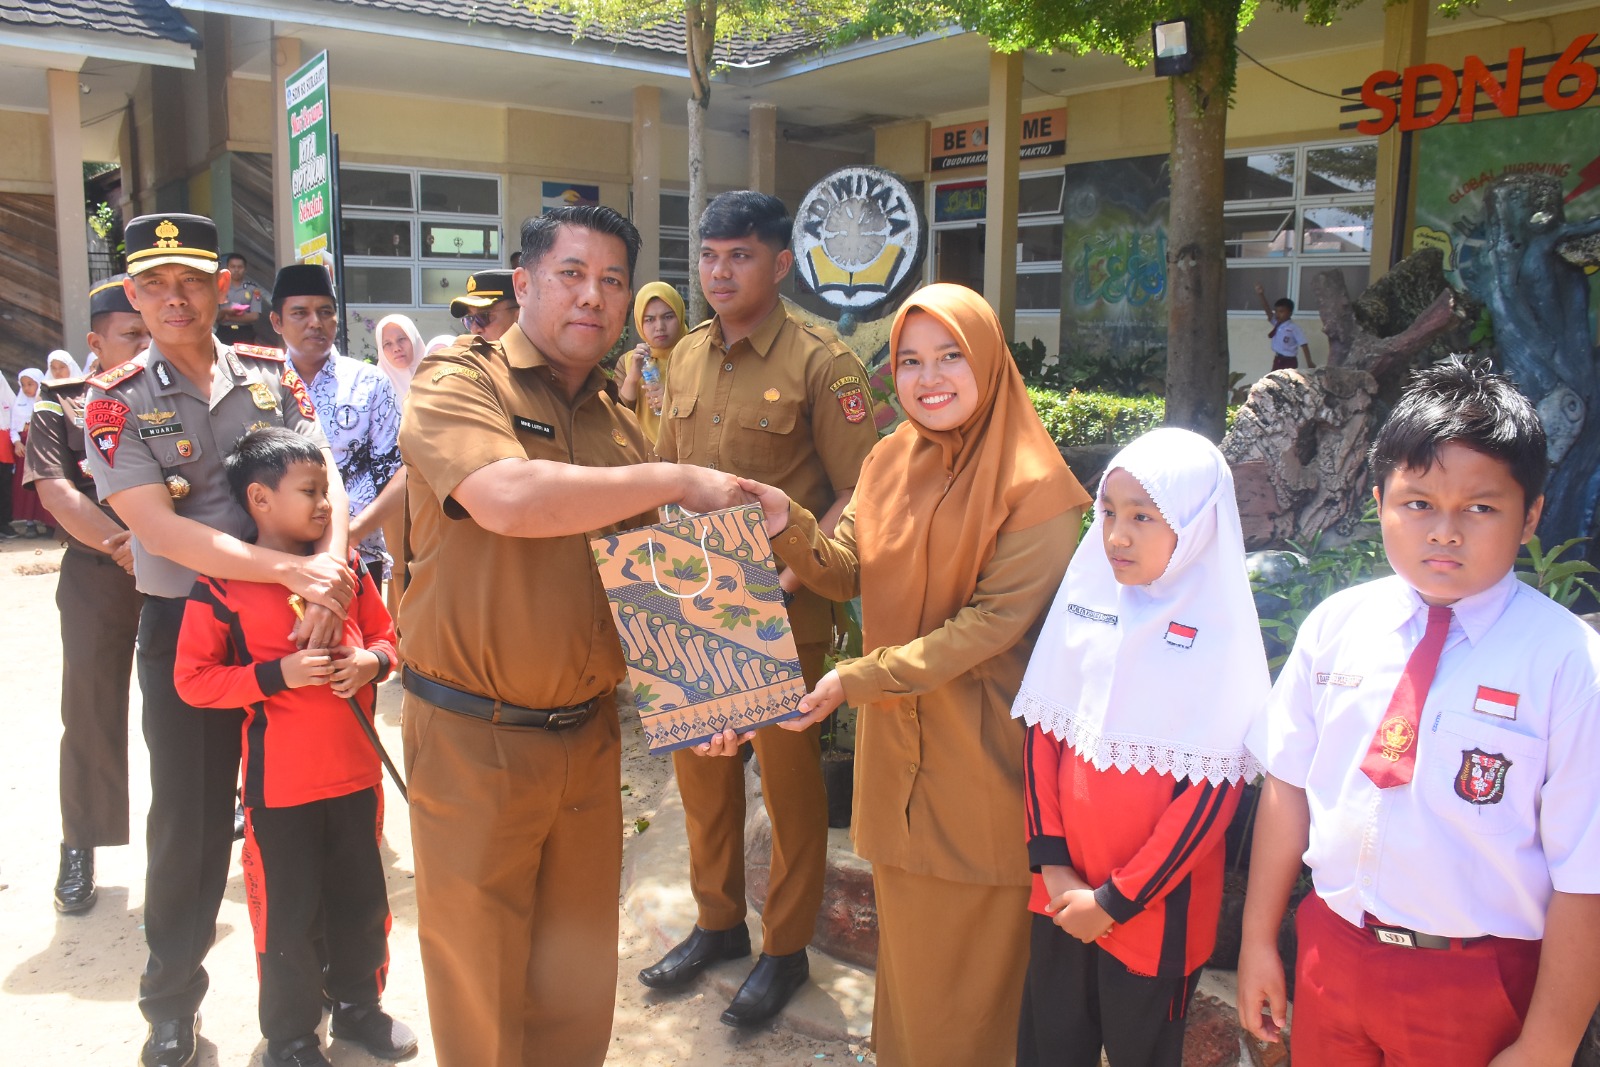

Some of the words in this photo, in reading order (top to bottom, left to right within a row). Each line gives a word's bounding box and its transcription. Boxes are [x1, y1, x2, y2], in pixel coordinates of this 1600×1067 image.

[1356, 47, 1525, 136] SDN
[1542, 33, 1598, 111] 6
[299, 132, 316, 166] KITA
[943, 130, 966, 151] BE
[1023, 116, 1052, 140] ME
[292, 153, 326, 199] CIPTAKAN
[1503, 162, 1571, 179] WARMING
[299, 191, 323, 224] Sekolah
[149, 425, 174, 436] MUARI
[1381, 748, 1400, 762] SD
[1384, 933, 1405, 943] SD
